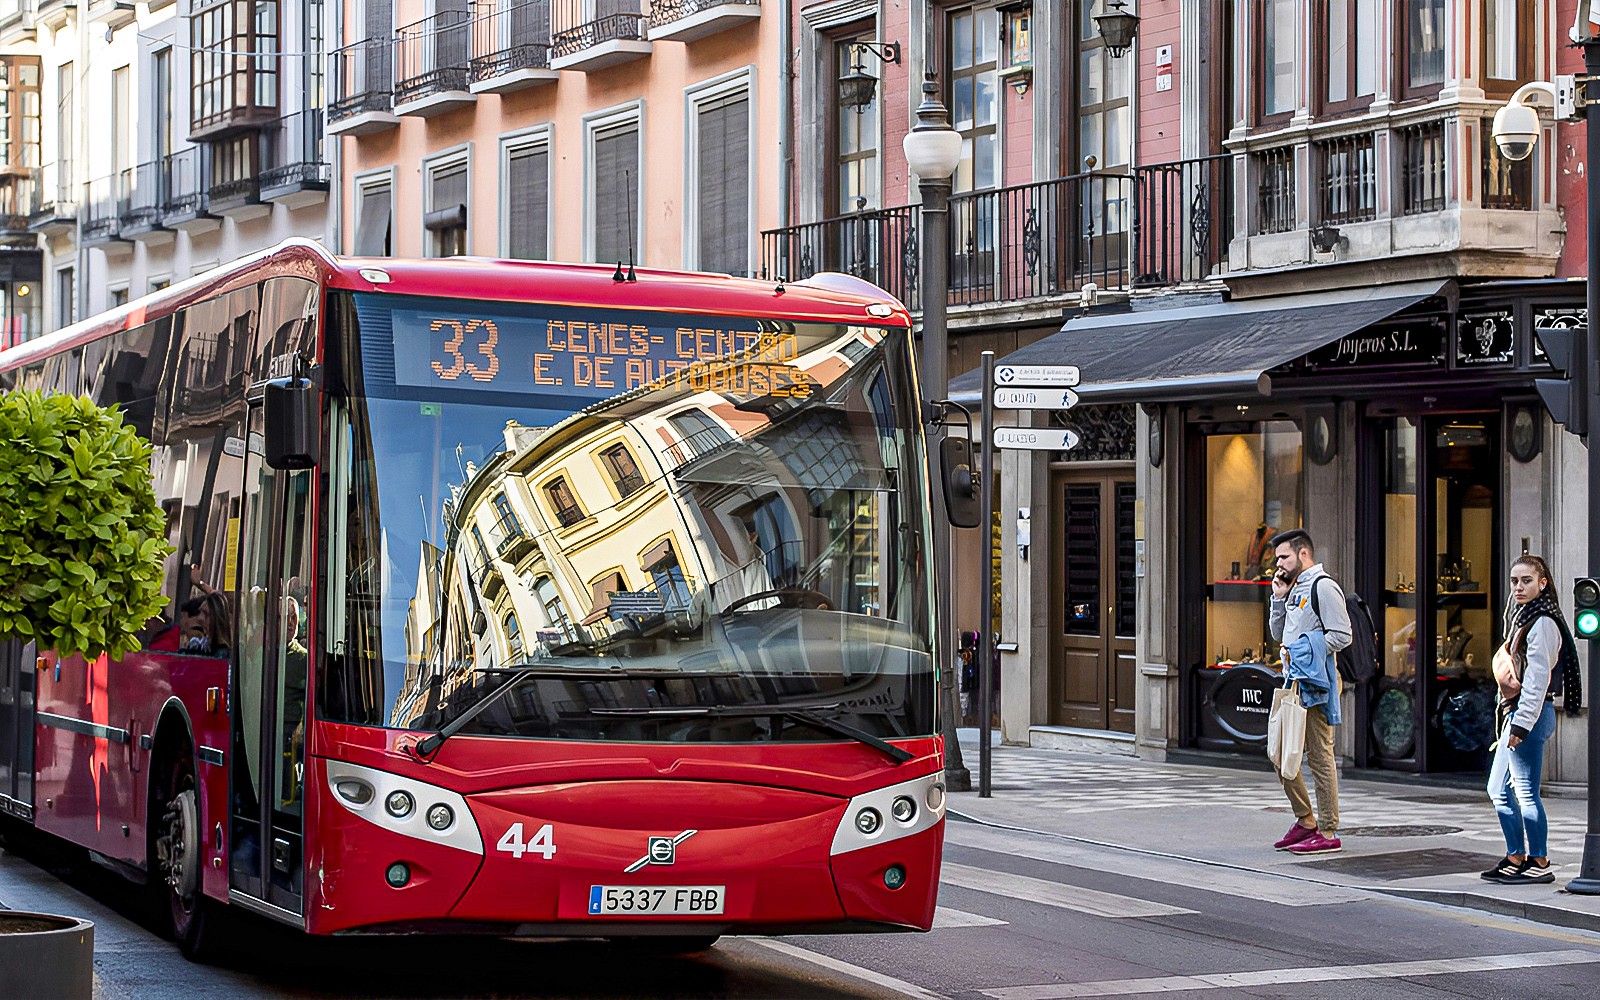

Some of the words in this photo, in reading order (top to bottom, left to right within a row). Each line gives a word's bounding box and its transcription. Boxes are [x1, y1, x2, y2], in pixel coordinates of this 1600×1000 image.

[430, 319, 499, 381] 33
[676, 327, 798, 363] CENTRO
[1330, 337, 1386, 364] Joyeros
[1390, 330, 1417, 351] S.L.
[534, 353, 563, 385] E.
[573, 355, 615, 388] DE
[625, 358, 811, 398] AUTOBUSES
[496, 822, 557, 860] 44
[606, 889, 667, 911] 5337
[674, 889, 718, 911] FBB
